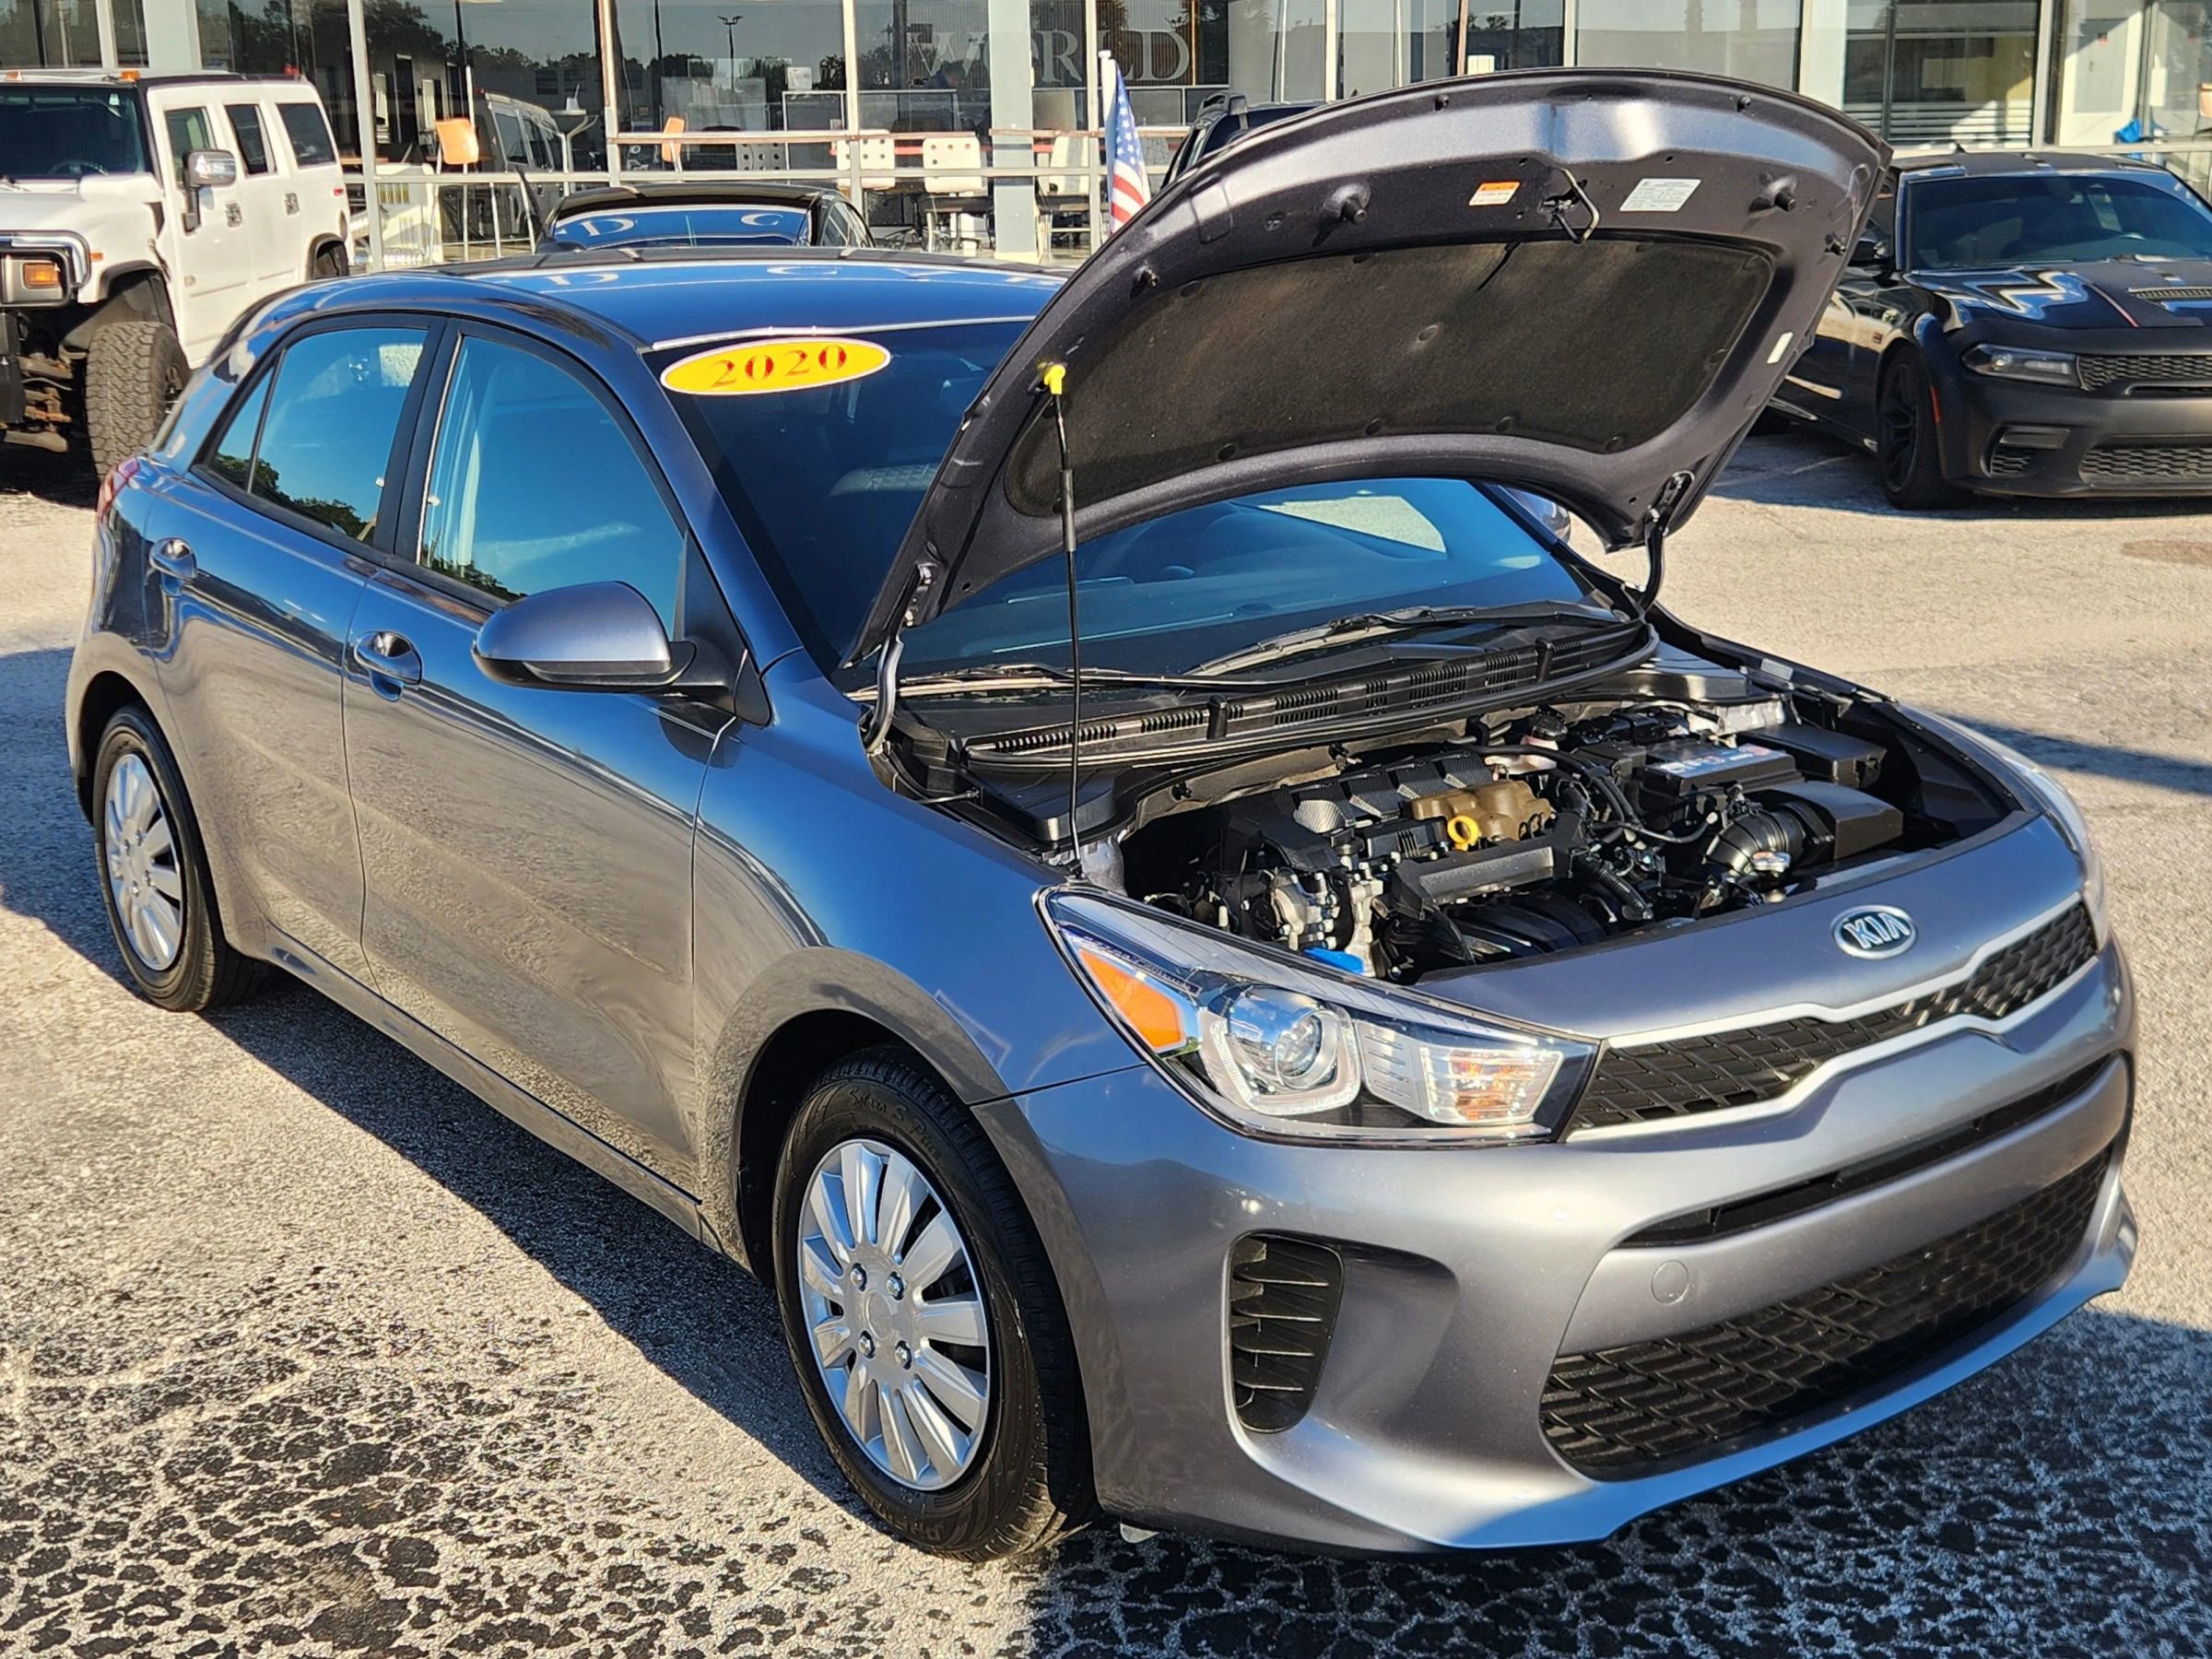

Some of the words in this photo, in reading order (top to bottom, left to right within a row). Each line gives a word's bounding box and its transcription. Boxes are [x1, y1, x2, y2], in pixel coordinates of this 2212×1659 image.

[907, 29, 1190, 81] WRD
[711, 344, 847, 389] 2020
[1842, 912, 1911, 949] KIA
